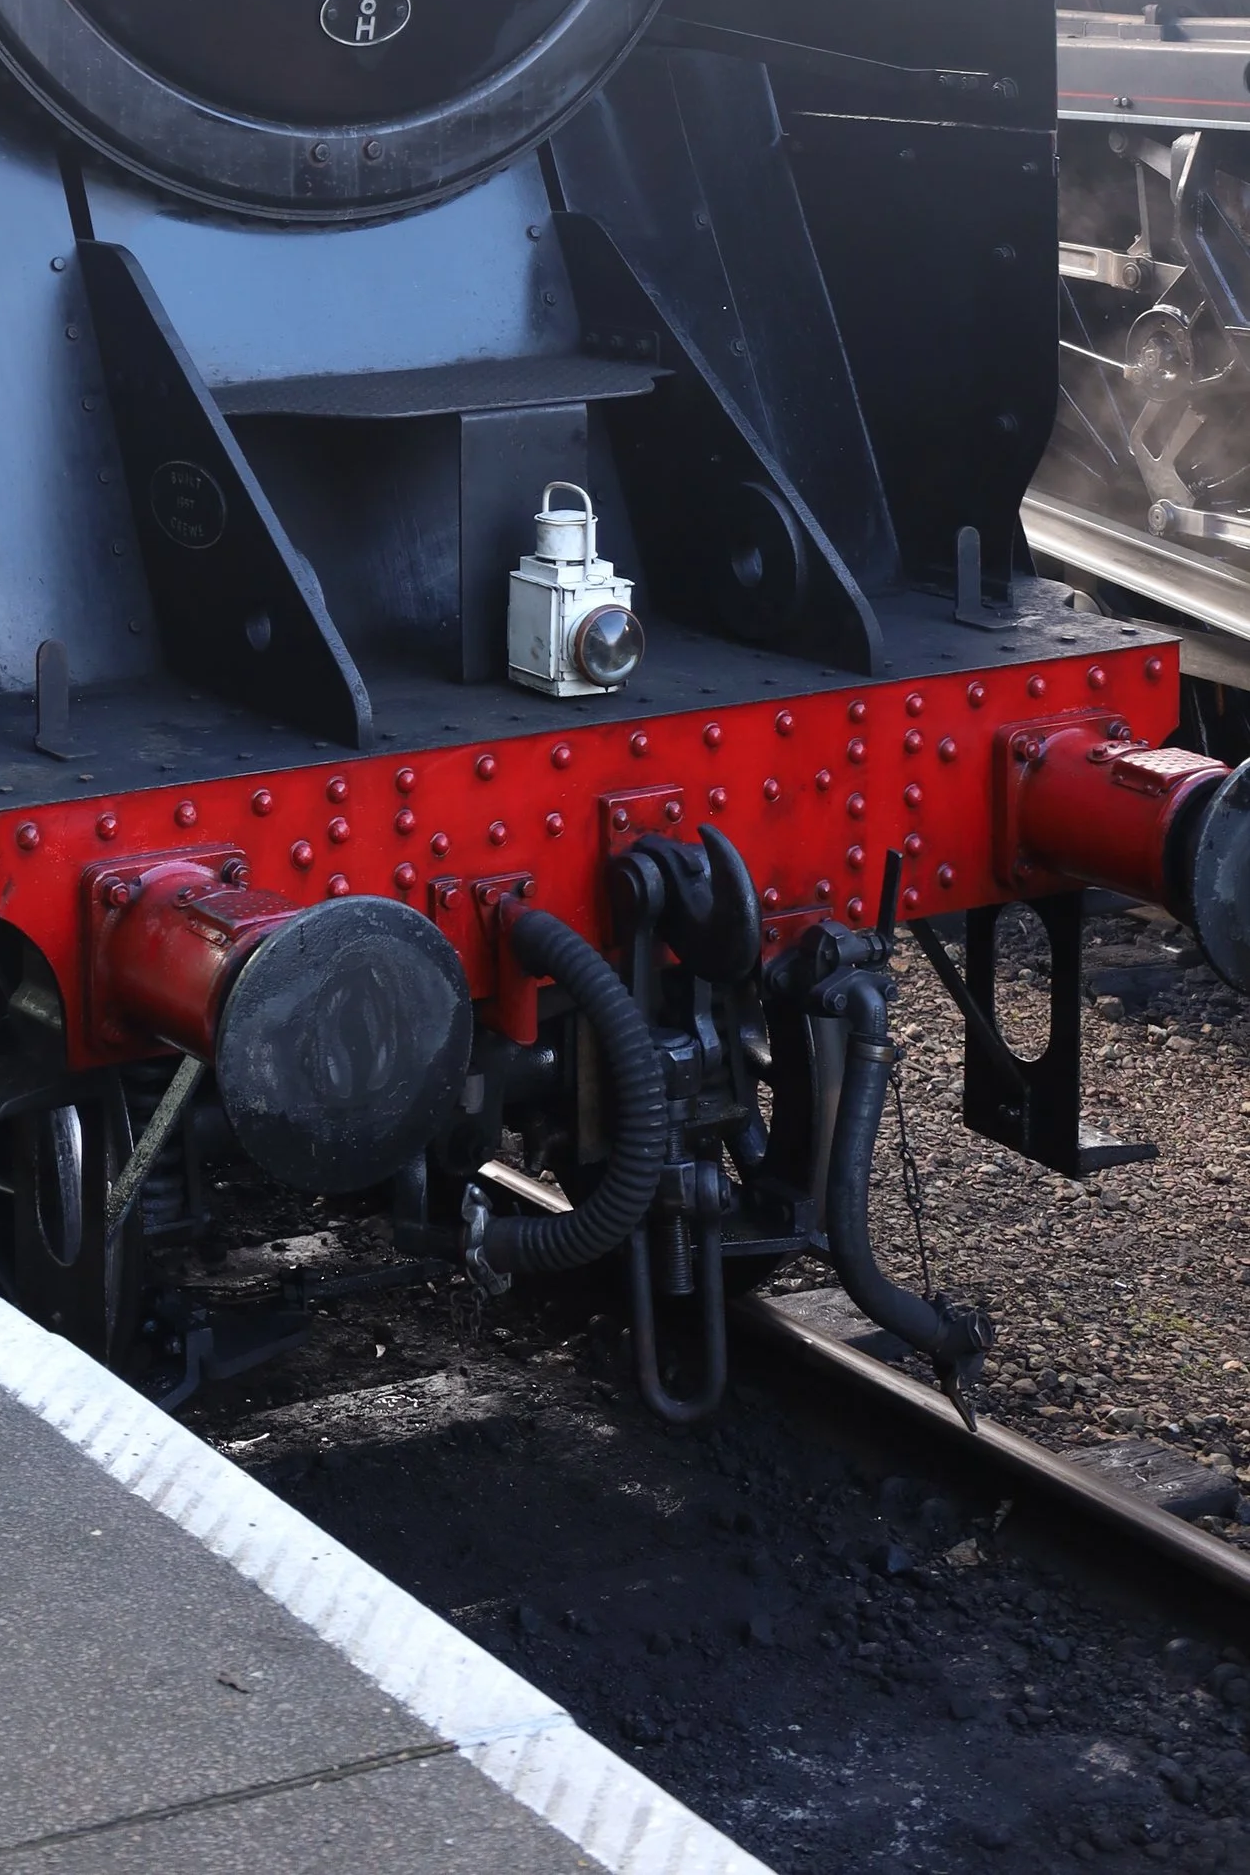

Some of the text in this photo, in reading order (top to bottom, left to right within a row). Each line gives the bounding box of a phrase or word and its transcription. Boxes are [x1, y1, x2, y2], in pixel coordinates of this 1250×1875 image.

[355, 16, 376, 41] H
[171, 471, 201, 489] BUILT
[170, 516, 204, 537] CREWE
